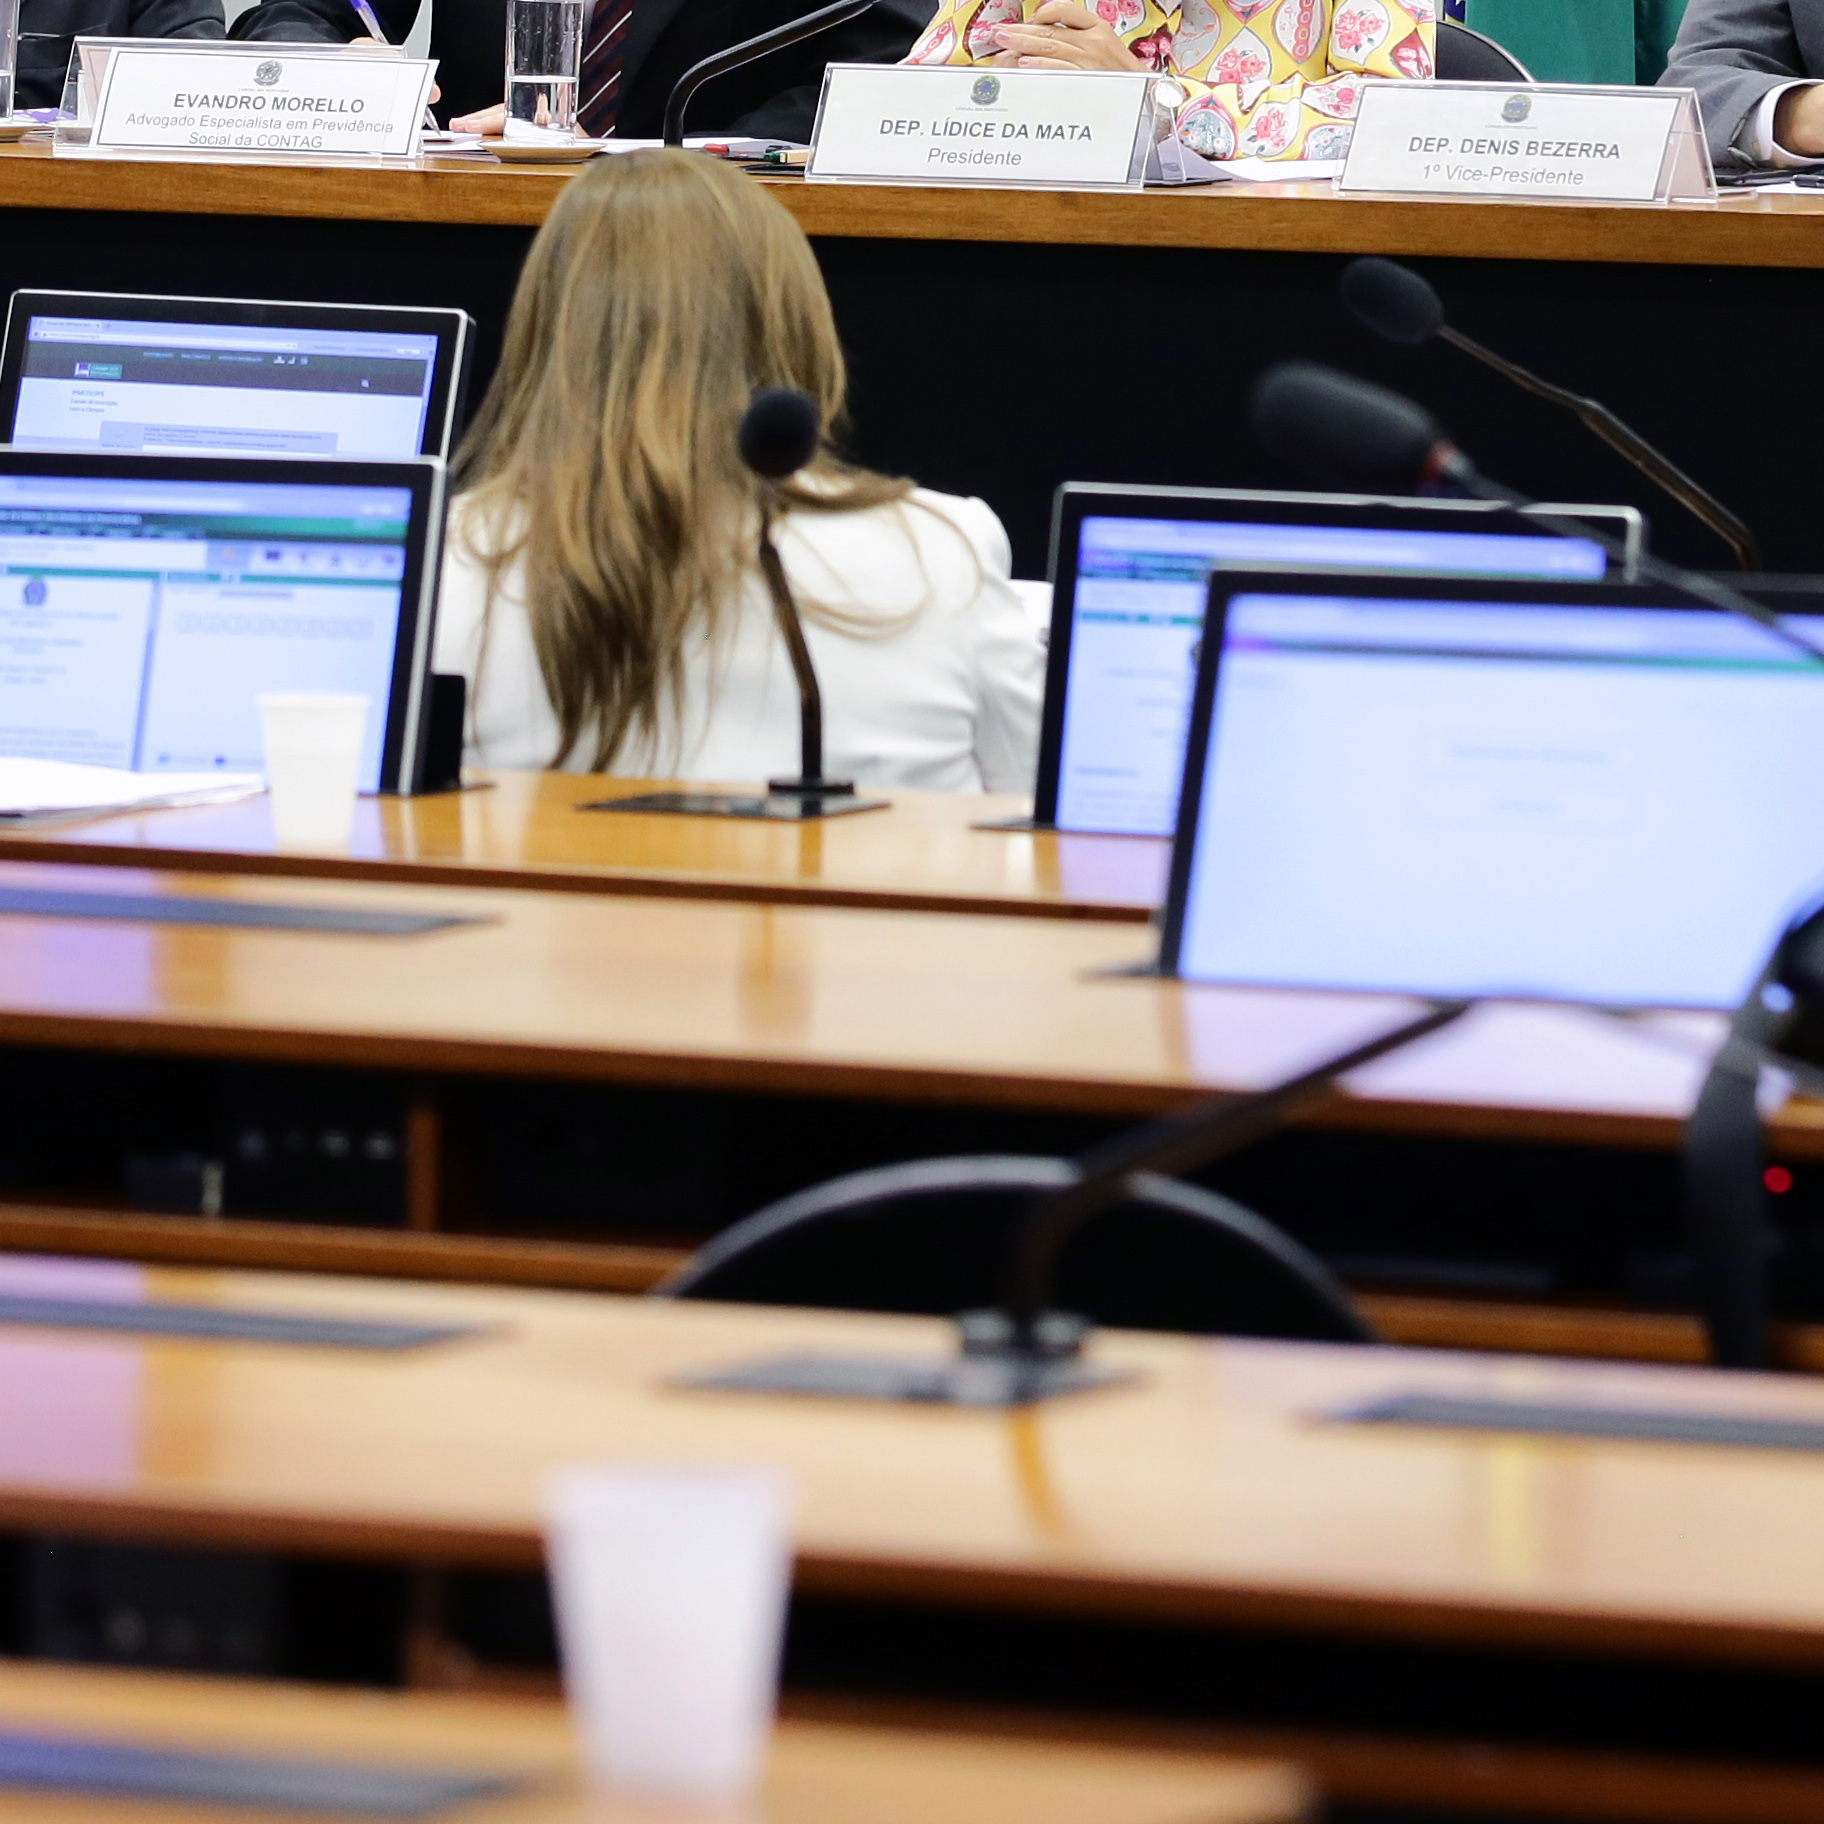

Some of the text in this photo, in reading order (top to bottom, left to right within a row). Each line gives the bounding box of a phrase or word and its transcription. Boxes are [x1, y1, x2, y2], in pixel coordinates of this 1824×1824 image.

[173, 93, 364, 114] EVANDRO MORELLO
[125, 113, 394, 134] Advogado Especialista em Previdência
[879, 117, 1093, 142] DEP. LÍDICE DA MATA
[188, 132, 323, 149] Social da CONTAG
[1408, 136, 1622, 160] DEP. DENIS BEZERRA
[926, 147, 1023, 167] Presidente
[1446, 165, 1585, 186] Vice-Presidente
